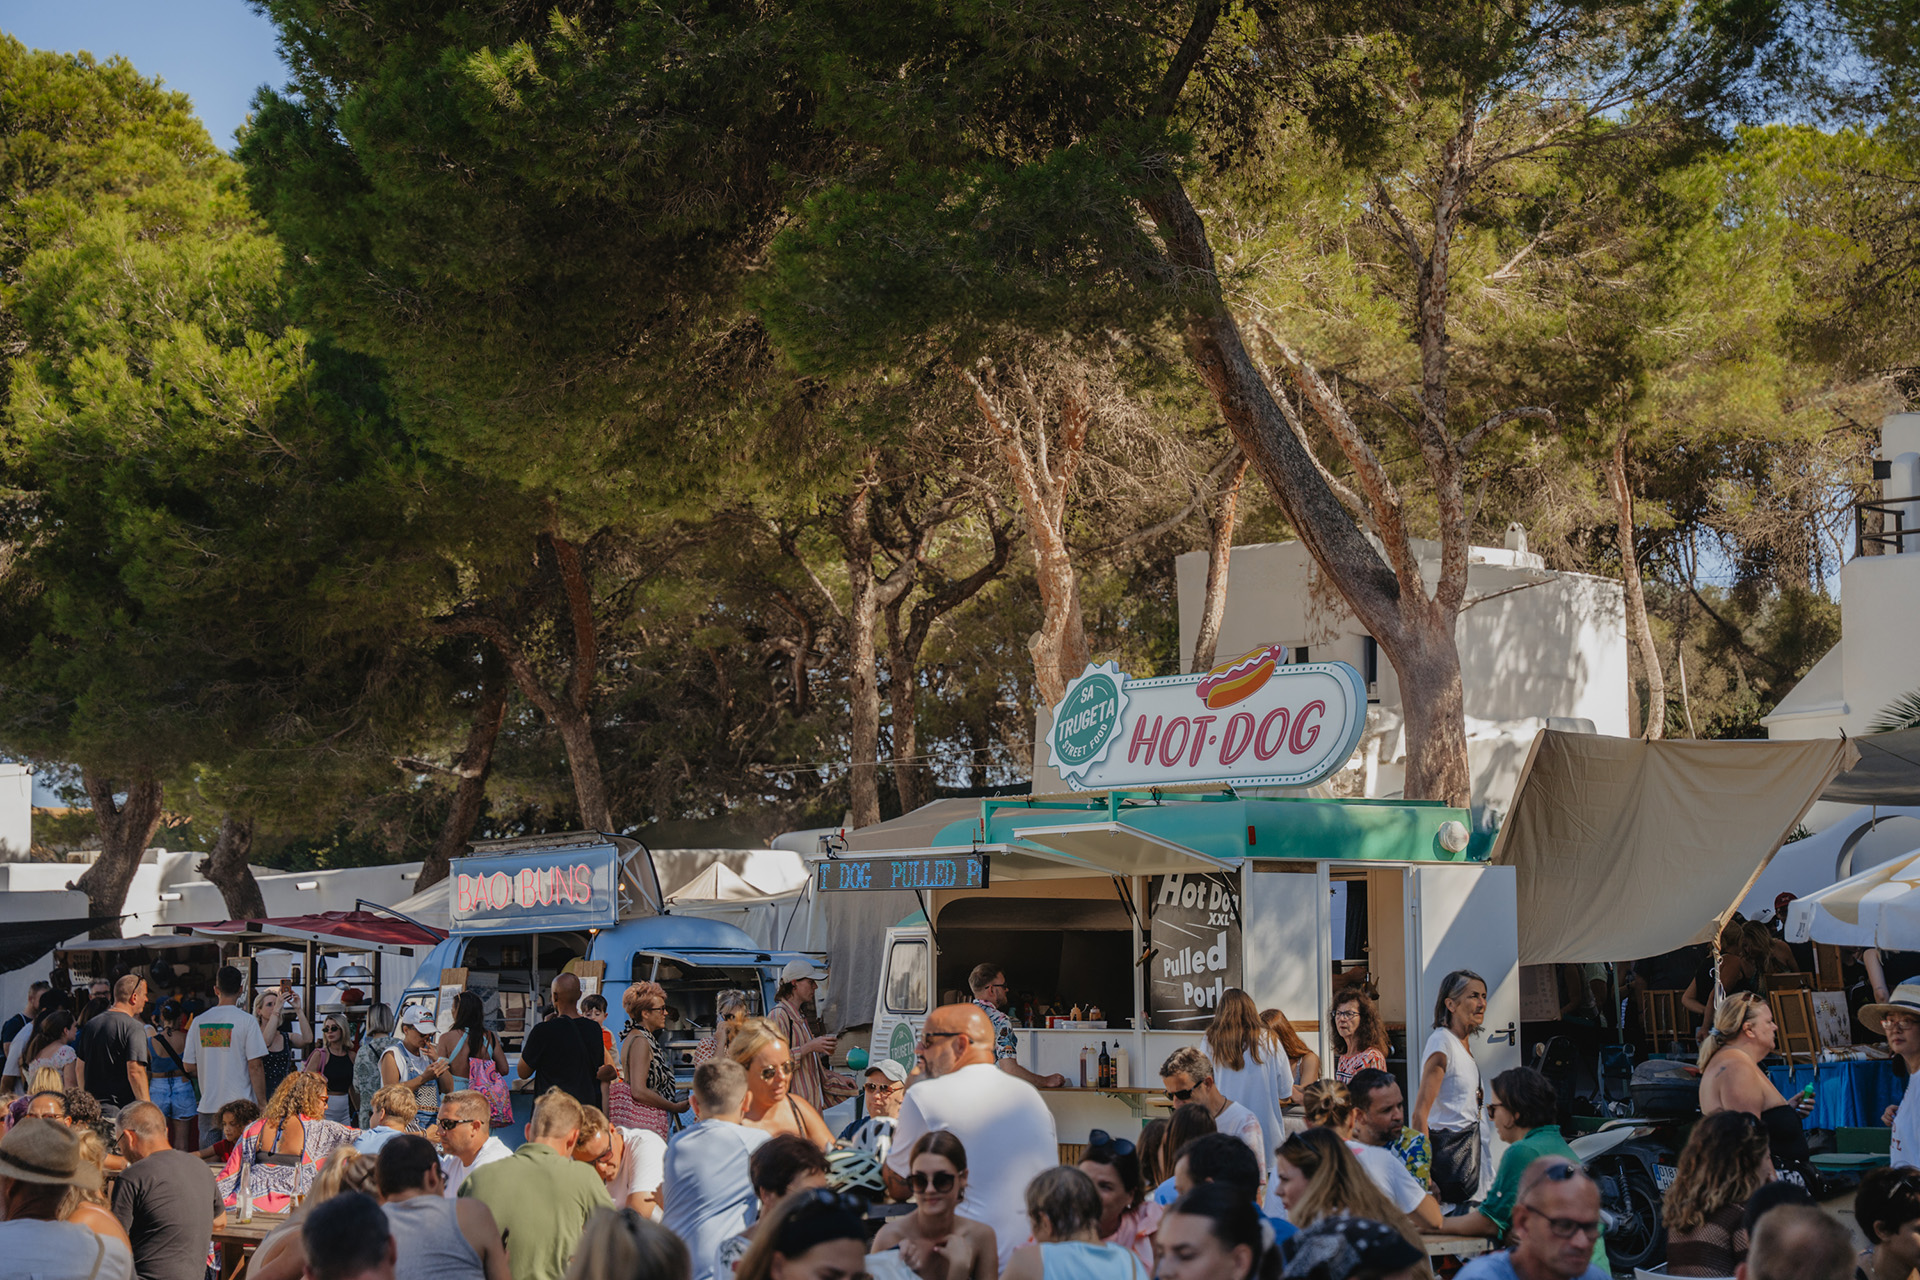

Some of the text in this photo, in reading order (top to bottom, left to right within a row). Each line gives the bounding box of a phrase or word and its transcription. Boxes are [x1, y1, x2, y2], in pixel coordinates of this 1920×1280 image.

[1081, 684, 1094, 704] SA
[1059, 698, 1115, 742] TRUGETA
[1062, 723, 1108, 757] STREET FOOD
[458, 864, 592, 911] BAO BUNS
[839, 862, 872, 889] DOG
[889, 859, 957, 888] PULLED
[1157, 873, 1207, 910] Hot
[1207, 912, 1230, 927] XXL
[1163, 930, 1228, 978] Pulled
